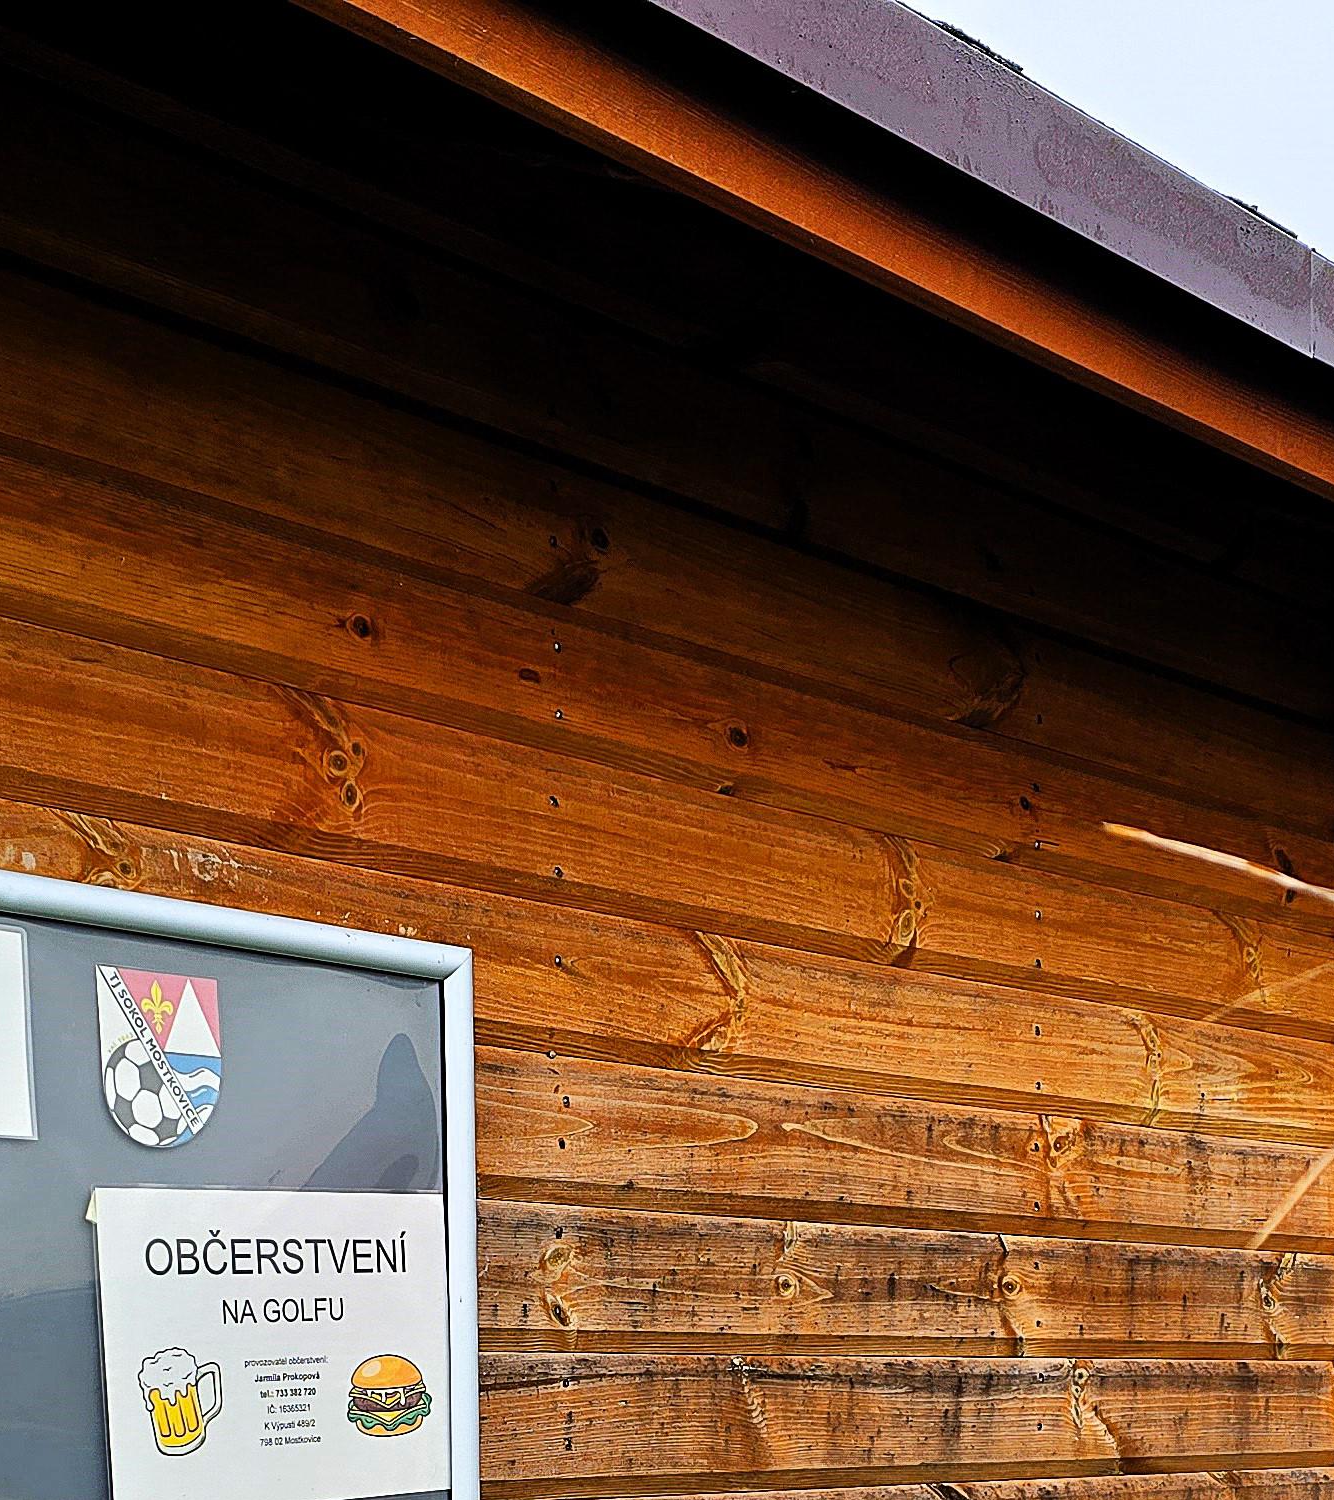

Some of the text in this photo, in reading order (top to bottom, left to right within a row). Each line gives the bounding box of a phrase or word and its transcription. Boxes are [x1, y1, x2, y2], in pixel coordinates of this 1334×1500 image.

[109, 971, 122, 989] TJ
[118, 989, 147, 1038] SOKOL
[146, 1038, 200, 1127] MOSTKOVICE
[145, 1229, 407, 1276] OBČERSTVENÍ
[222, 1298, 344, 1325] NA GOLFU
